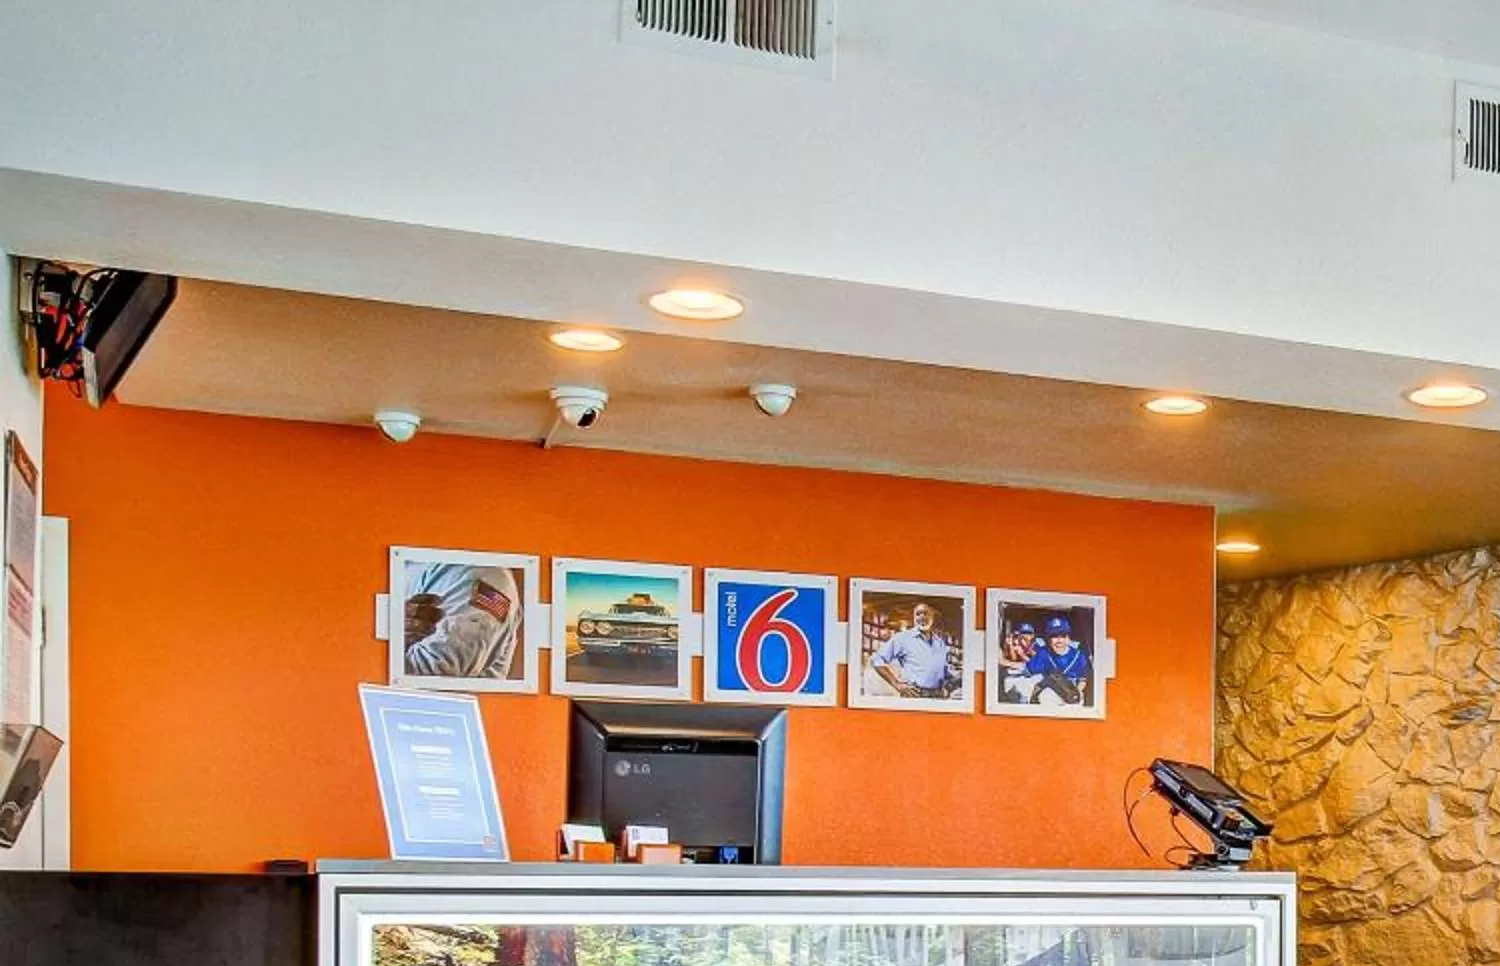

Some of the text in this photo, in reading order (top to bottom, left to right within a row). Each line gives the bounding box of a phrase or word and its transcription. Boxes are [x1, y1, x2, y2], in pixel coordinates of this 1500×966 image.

[725, 591, 737, 627] motel
[736, 588, 812, 694] 6
[633, 763, 650, 775] LG
